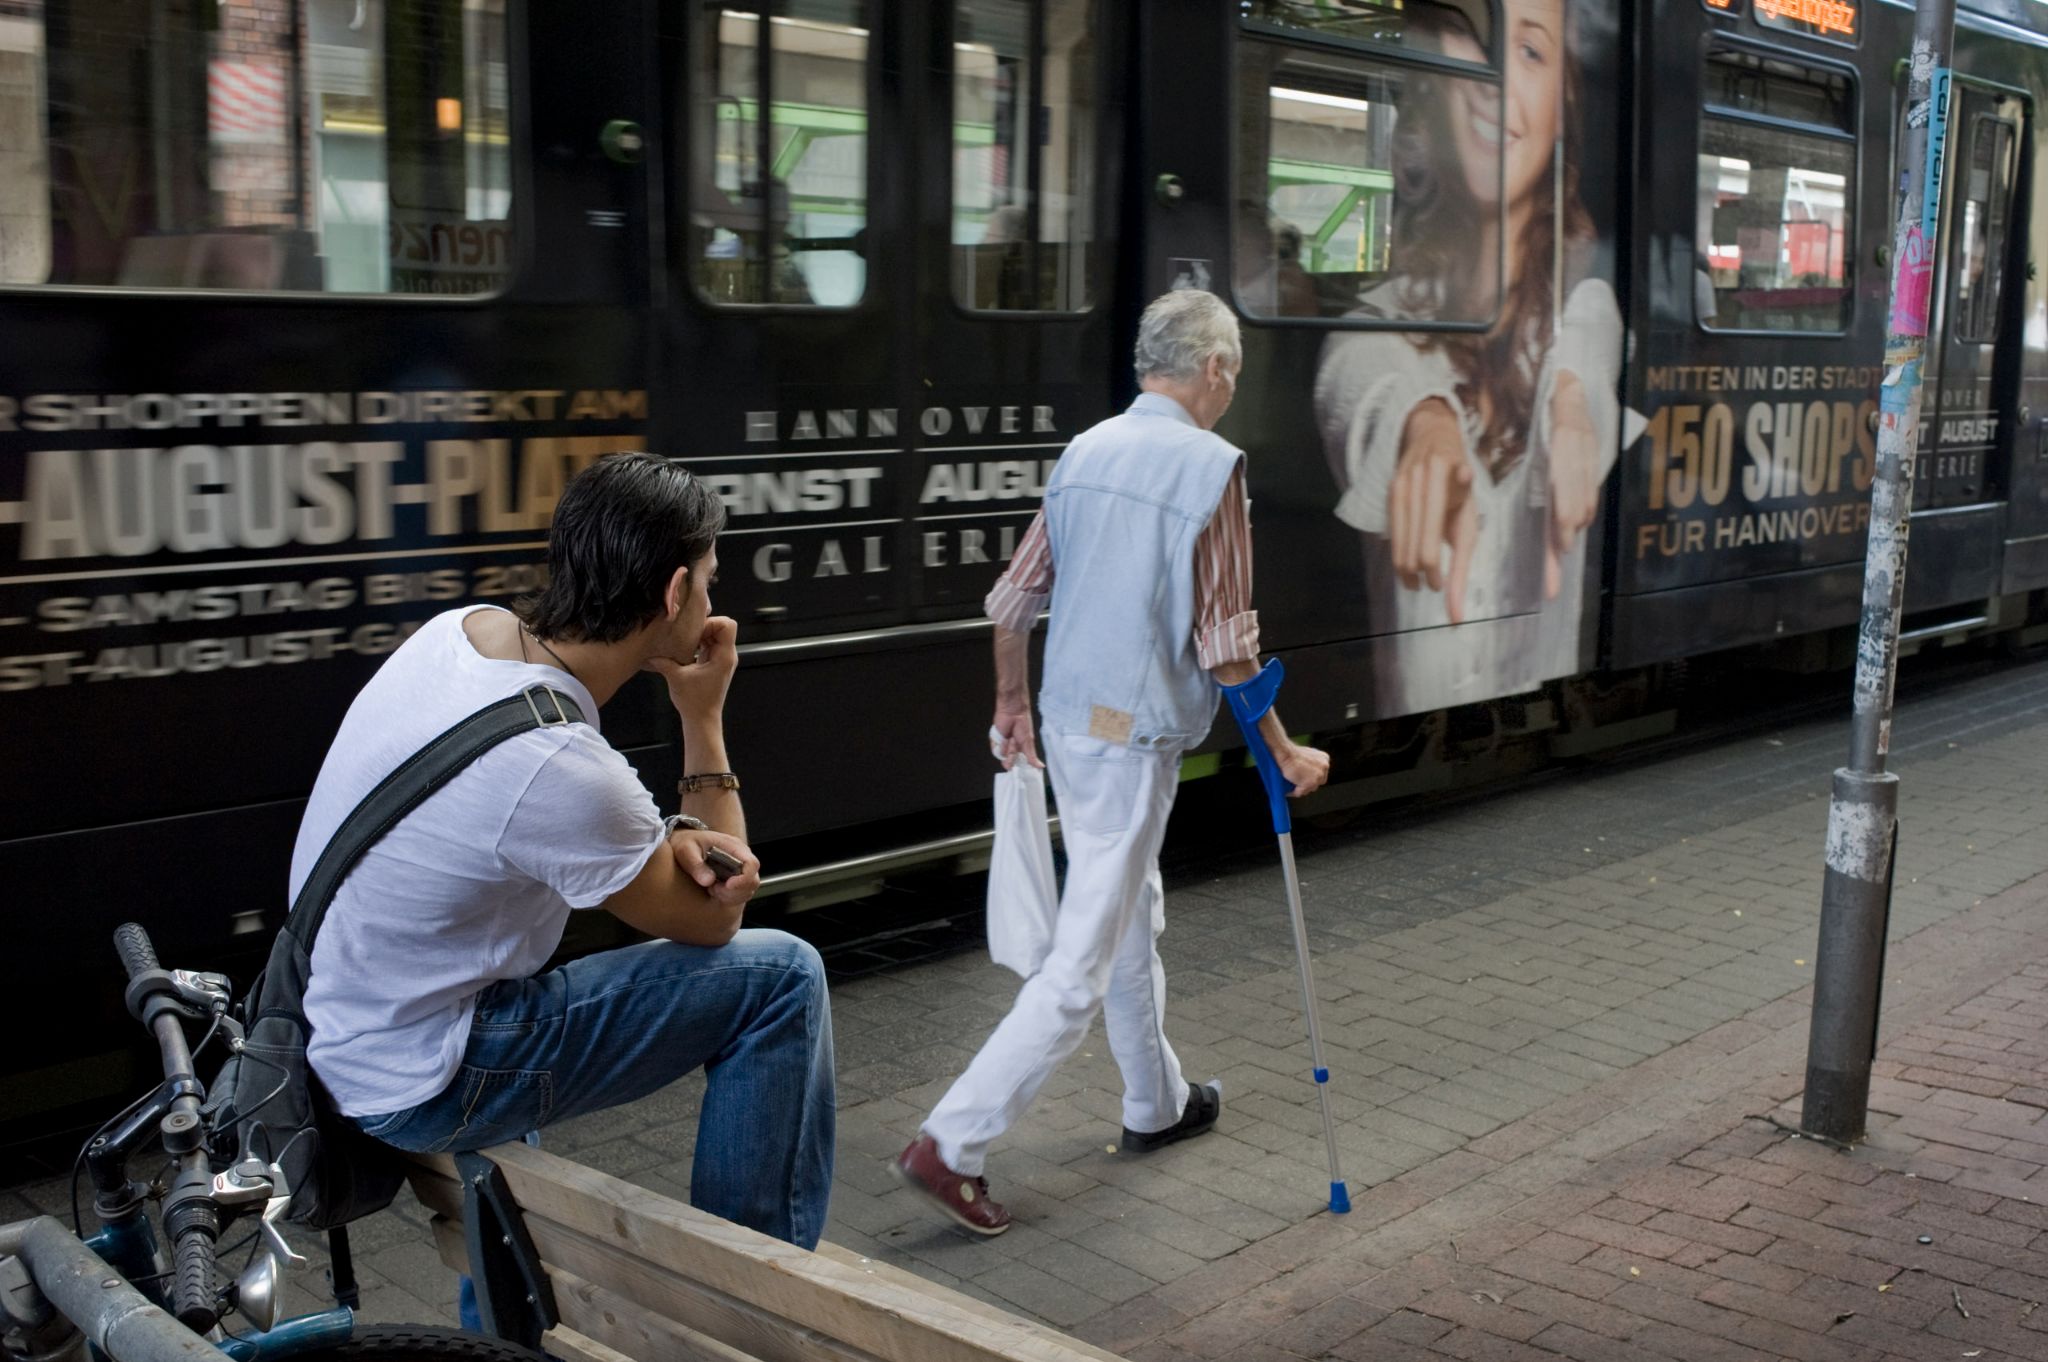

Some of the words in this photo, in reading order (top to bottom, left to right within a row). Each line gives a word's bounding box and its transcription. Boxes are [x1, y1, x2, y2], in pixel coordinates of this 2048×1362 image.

[1646, 366, 1738, 391] MITTEN
[1743, 367, 1766, 390] IN
[1772, 366, 1817, 390] DER
[1820, 365, 1882, 390] STADT
[21, 391, 353, 431] SHOPPEN
[357, 389, 568, 424] DIREKT
[567, 389, 648, 421] AM
[745, 406, 1056, 441] HANNOVER
[1940, 419, 1998, 443] AUGUST
[1645, 402, 1734, 509] 150
[1743, 400, 1876, 503] SHOPS
[695, 467, 882, 516] RNST
[920, 460, 1058, 504] AUGU
[753, 526, 1016, 582] GALERI
[1637, 510, 1705, 560] FÜR
[1715, 503, 1870, 550] HANNOVER
[37, 576, 357, 632] SAMSTAG
[365, 569, 466, 605] BIS
